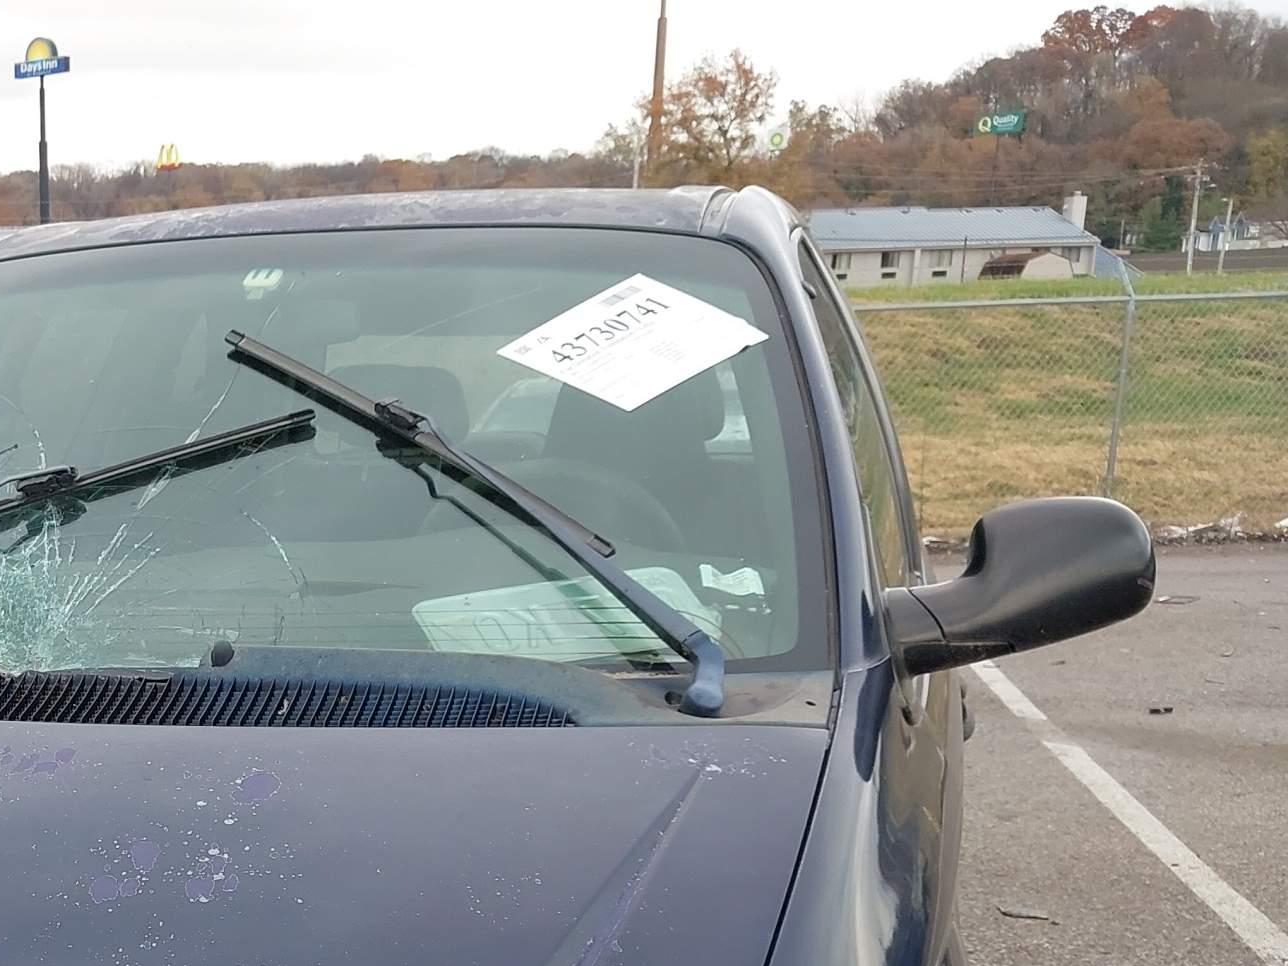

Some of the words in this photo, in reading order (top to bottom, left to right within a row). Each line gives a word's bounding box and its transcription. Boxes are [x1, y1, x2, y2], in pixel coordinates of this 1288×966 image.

[20, 61, 41, 74] Days
[42, 59, 58, 69] Inn
[993, 114, 1019, 127] Quality
[551, 297, 671, 363] 43730741
